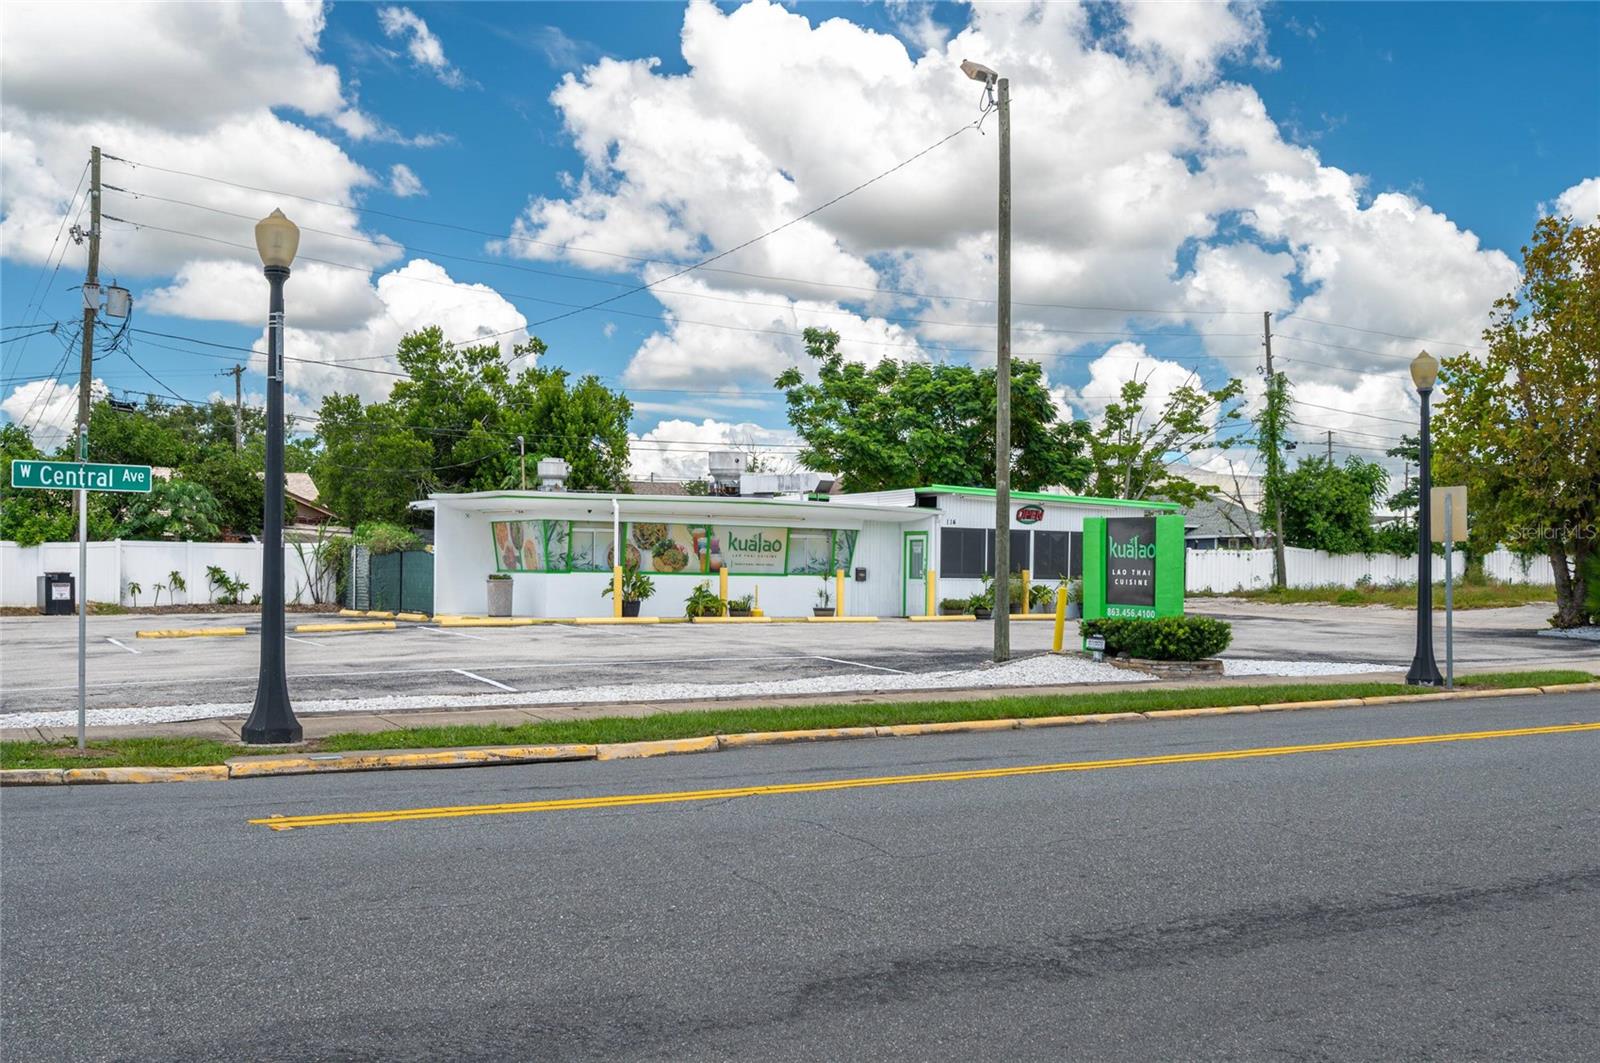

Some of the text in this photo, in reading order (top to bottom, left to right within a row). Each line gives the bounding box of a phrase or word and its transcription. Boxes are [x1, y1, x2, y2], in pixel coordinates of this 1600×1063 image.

[20, 464, 145, 487] W Central Ave
[1114, 578, 1148, 586] CUISINE
[1106, 608, 1156, 618] 863.456.4100
